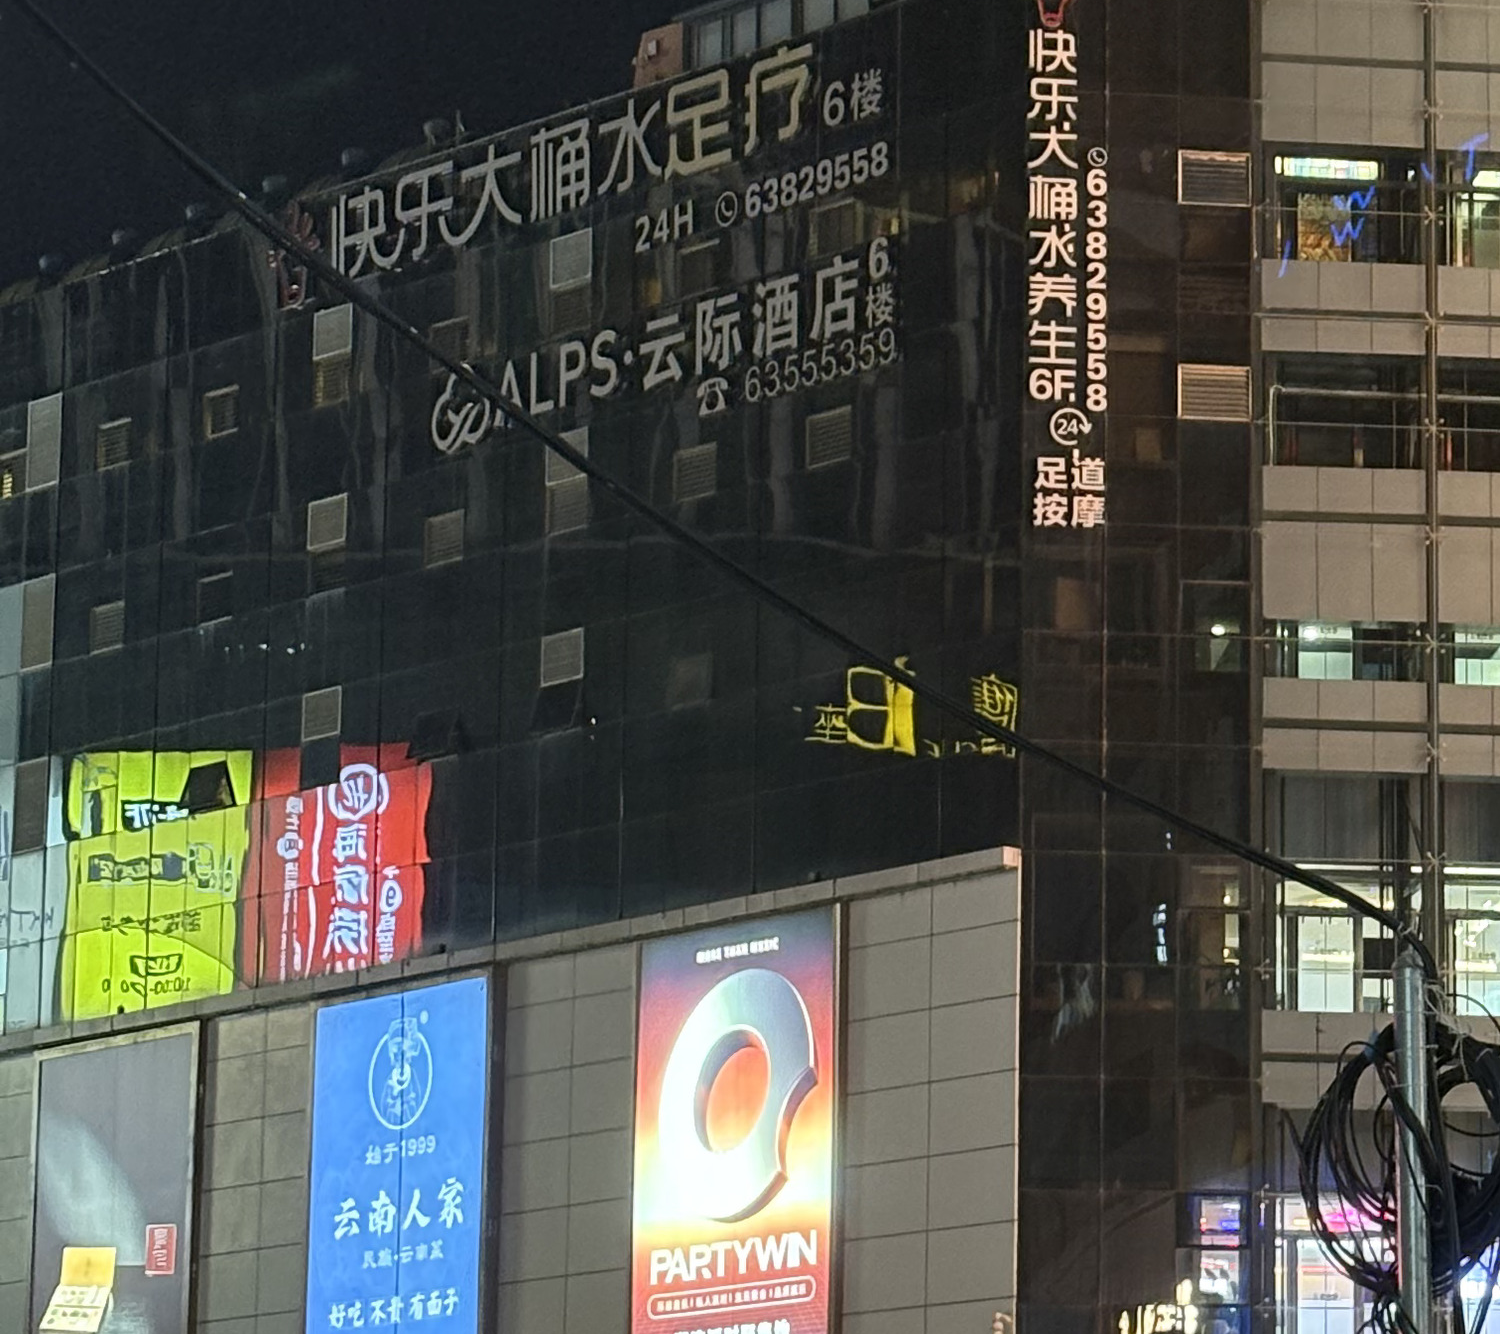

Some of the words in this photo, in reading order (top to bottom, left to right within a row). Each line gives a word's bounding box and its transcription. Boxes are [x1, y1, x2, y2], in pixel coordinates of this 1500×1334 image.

[330, 43, 814, 278] 快乐大桶水足疗
[822, 69, 883, 127] 6楼
[635, 200, 694, 254] 24H
[744, 141, 890, 220] 63829558
[1085, 168, 1108, 412] 63829558
[744, 327, 897, 403] 63555359
[1033, 493, 1105, 528] 按摩
[334, 1176, 464, 1241] 云南人家
[650, 1229, 817, 1286] PARTYWIN
[329, 1300, 365, 1329] 好吃
